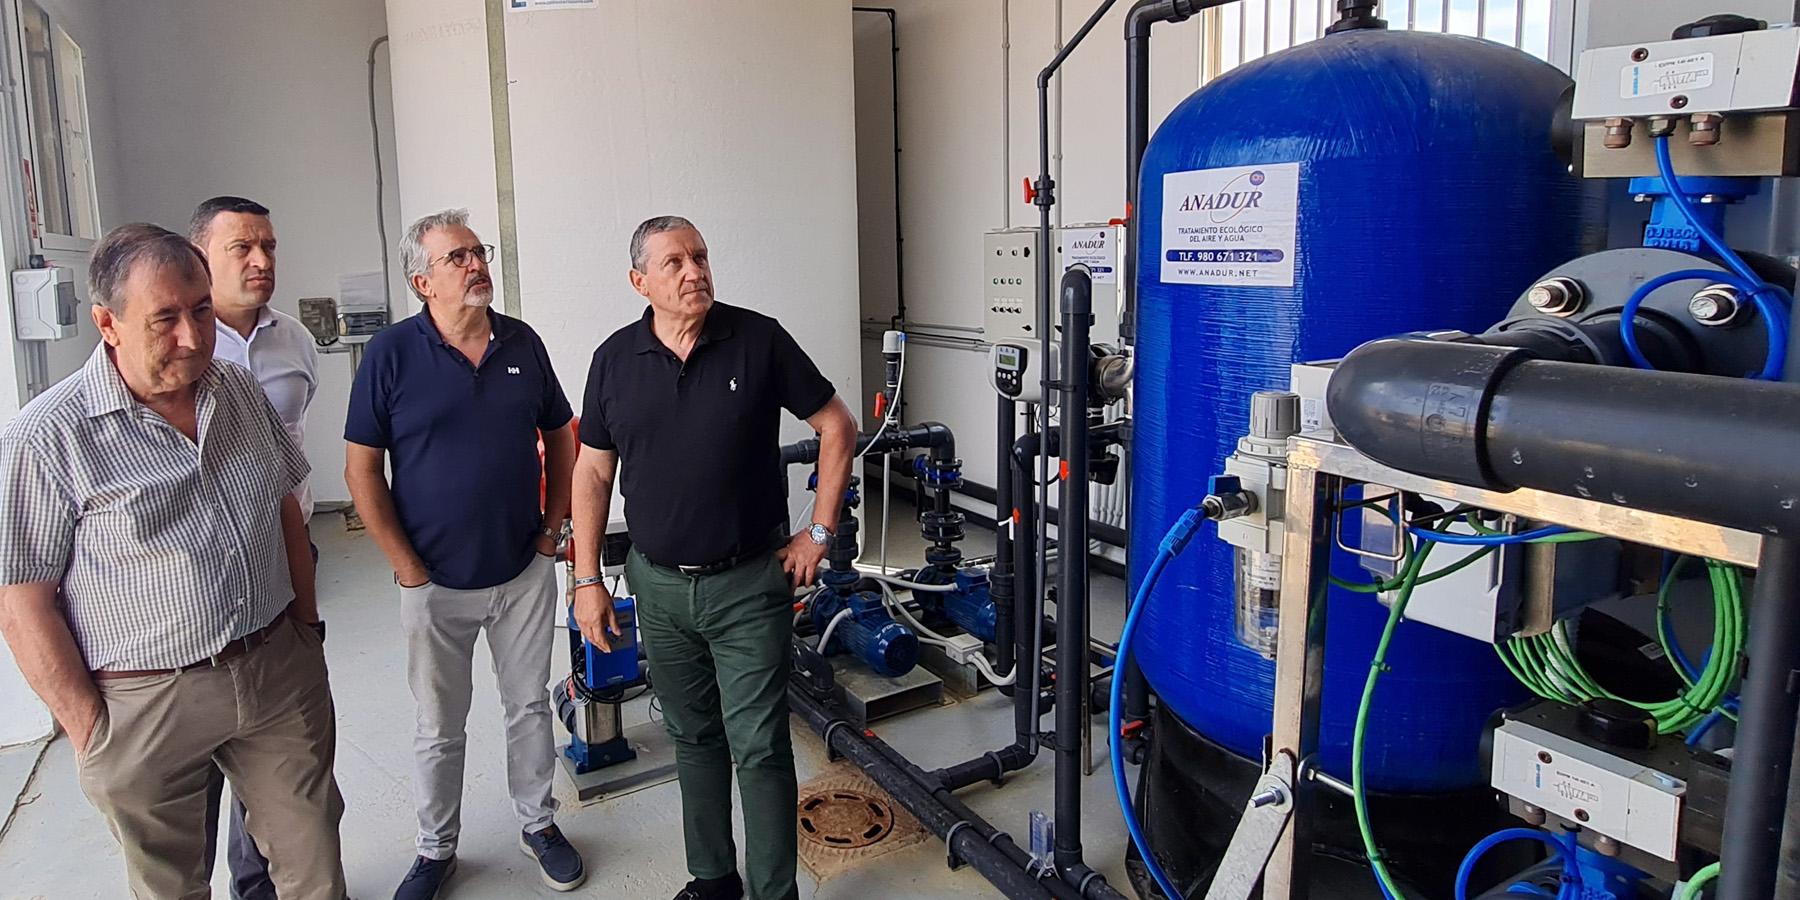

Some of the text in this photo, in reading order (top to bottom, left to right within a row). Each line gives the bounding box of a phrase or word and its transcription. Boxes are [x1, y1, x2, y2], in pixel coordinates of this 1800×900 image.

[1179, 191, 1263, 211] ANADUR
[1219, 225, 1264, 234] ECOLÓGICO
[1072, 240, 1105, 249] ANADUR
[1178, 251, 1258, 262] TLF. 980 671 321
[1178, 269, 1258, 277] WWW.ANADUR.NET
